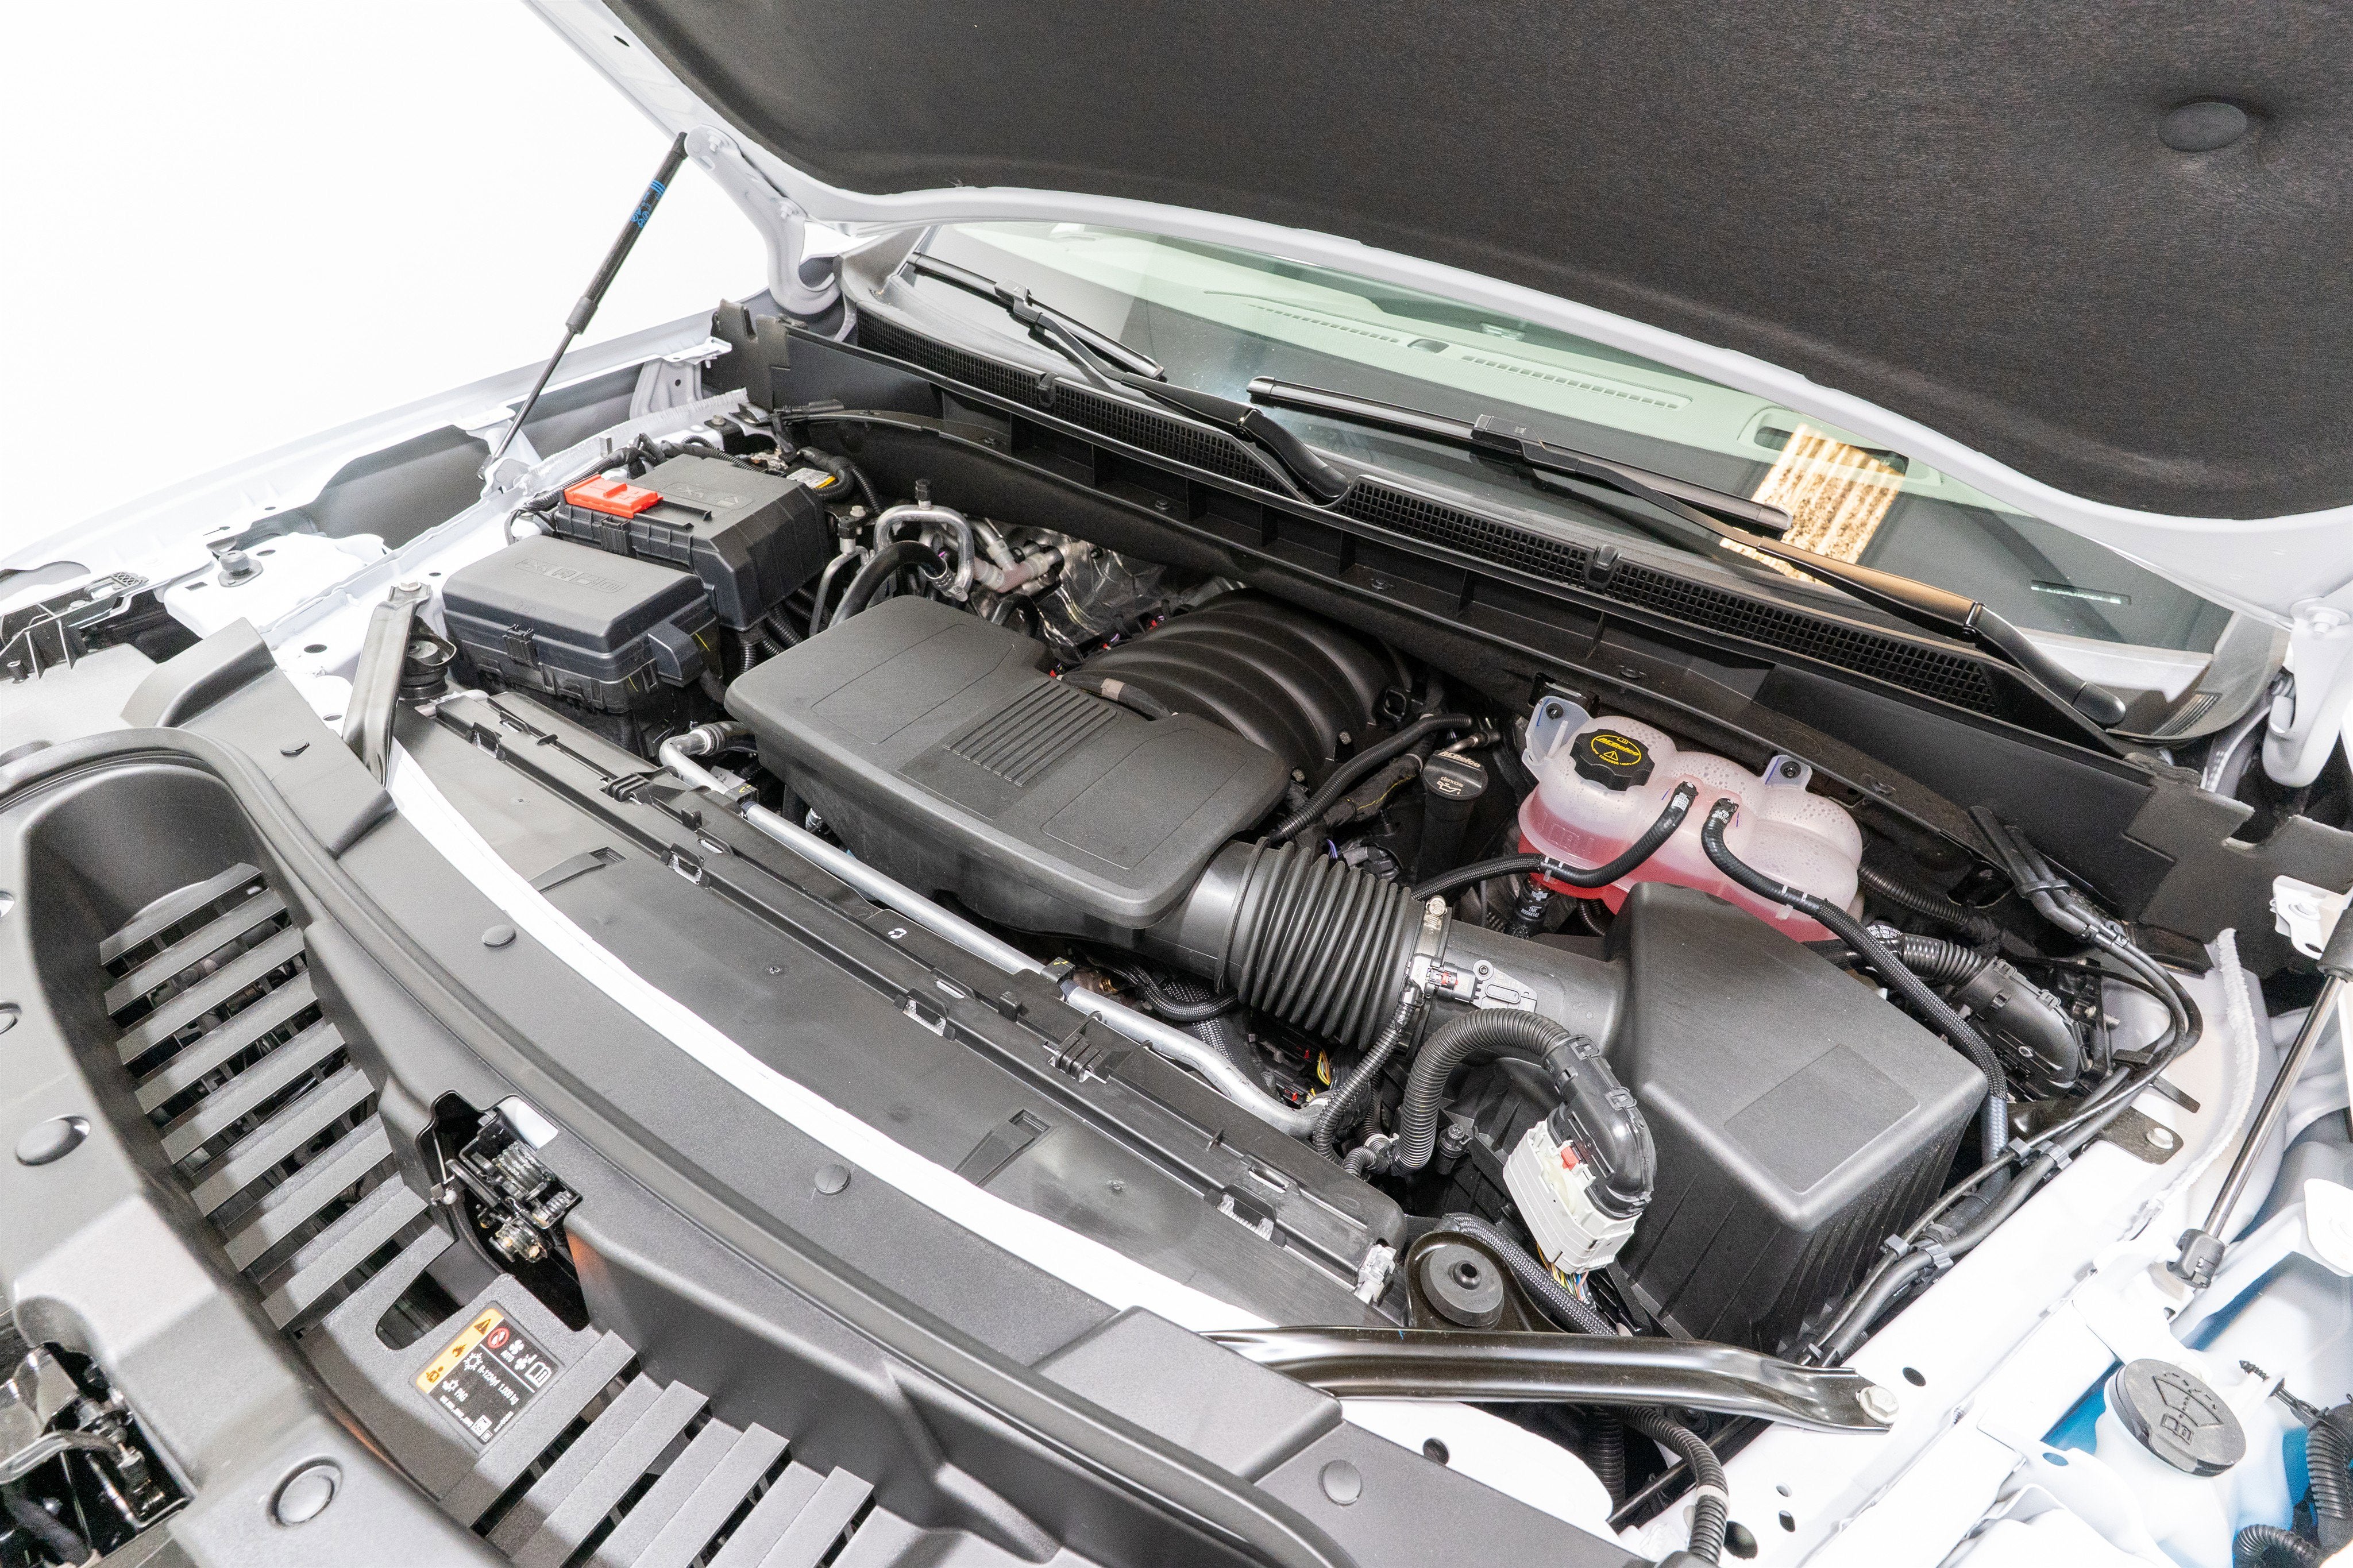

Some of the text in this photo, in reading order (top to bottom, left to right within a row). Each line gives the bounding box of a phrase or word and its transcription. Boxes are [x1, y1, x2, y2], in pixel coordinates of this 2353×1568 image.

[1597, 737, 1640, 756] ACDelco
[1438, 751, 1481, 768] ACDelco
[1440, 777, 1464, 787] dexos
[500, 1350, 515, 1362] AUTO
[477, 1365, 519, 1405] R-1234yf 1.000 kg
[454, 1388, 469, 1402] PAG
